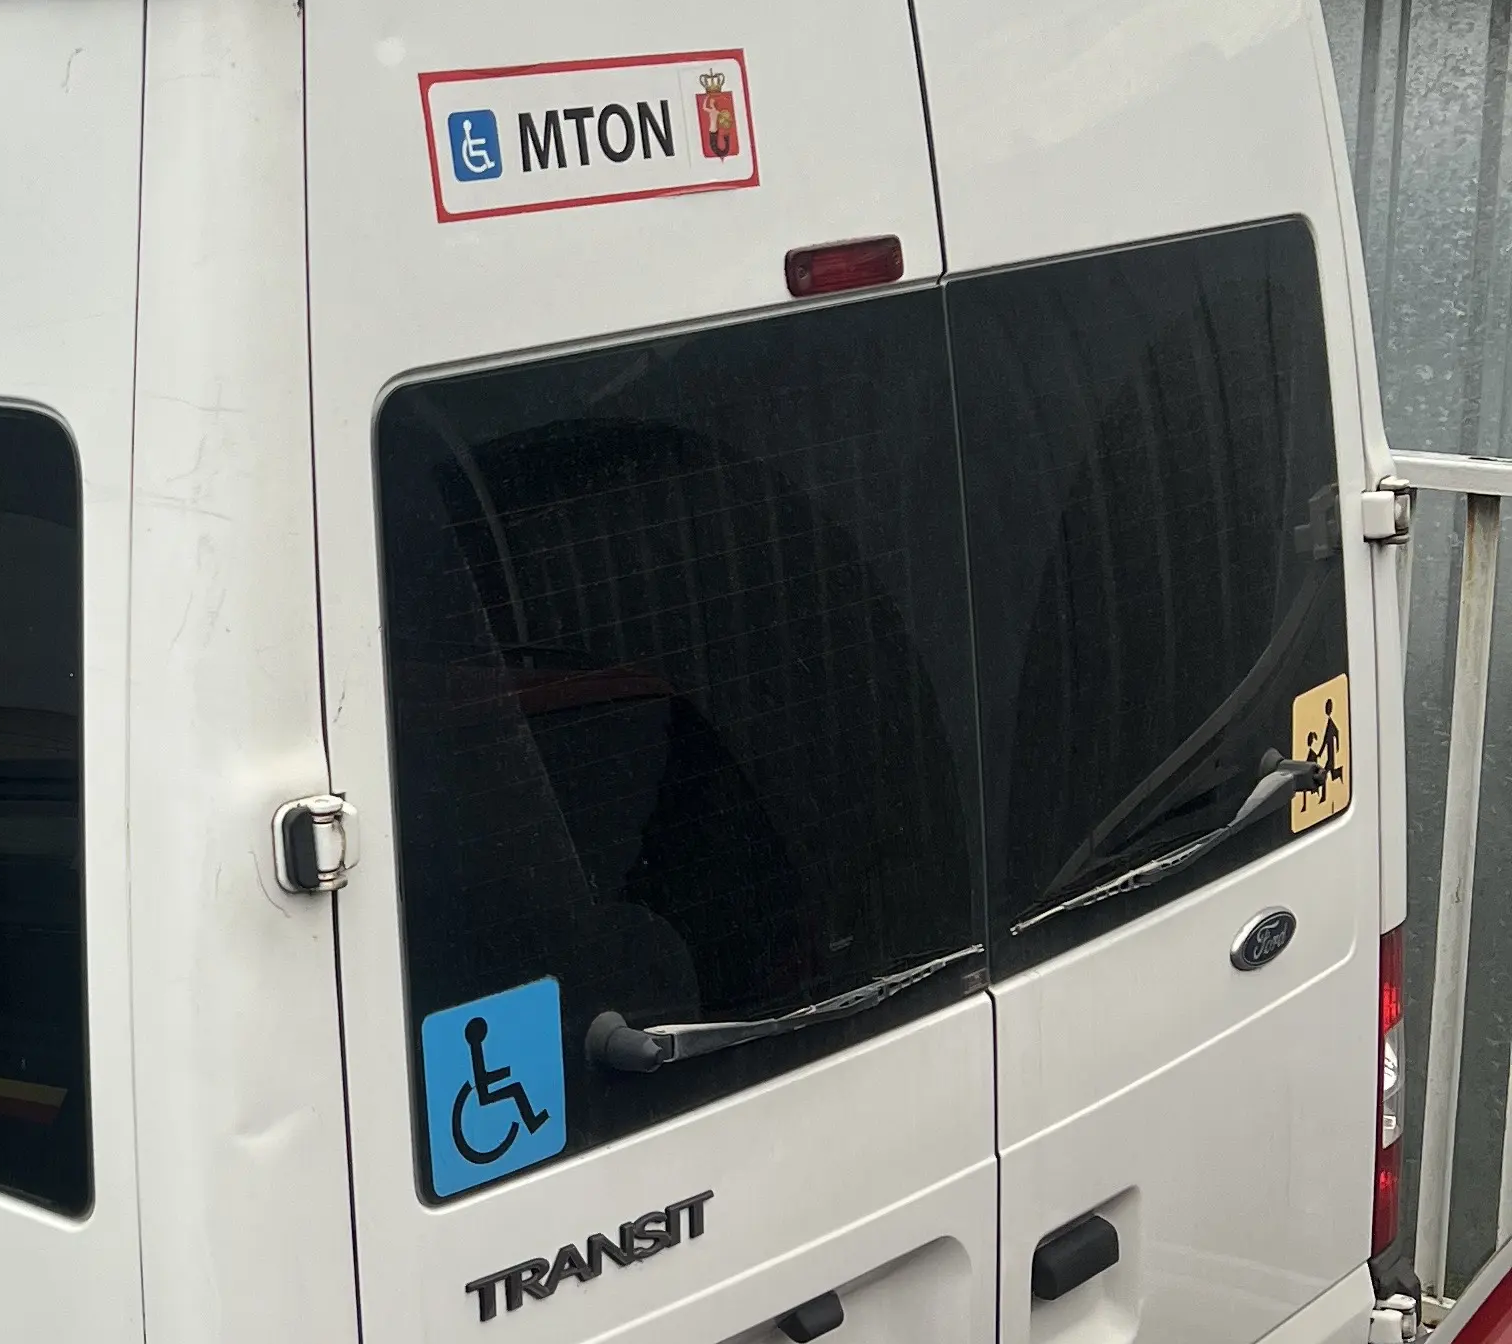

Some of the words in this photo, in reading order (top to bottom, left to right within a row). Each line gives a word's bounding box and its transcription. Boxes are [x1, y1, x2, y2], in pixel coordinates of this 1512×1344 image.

[518, 99, 675, 172] MTON
[1253, 919, 1289, 960] Ford
[465, 1189, 714, 1323] TRANSIT
